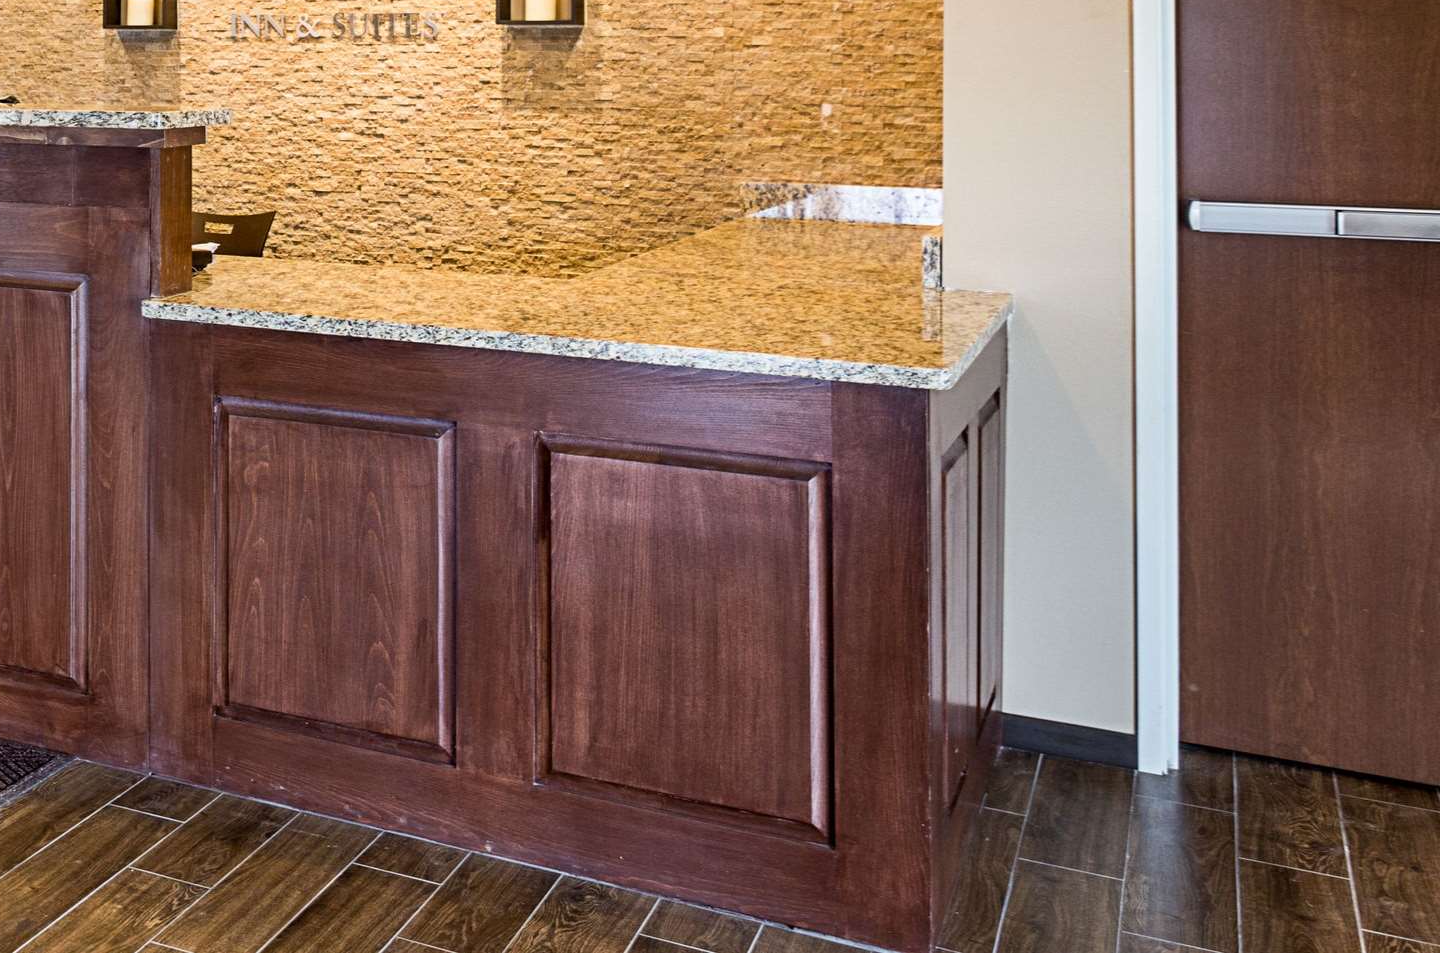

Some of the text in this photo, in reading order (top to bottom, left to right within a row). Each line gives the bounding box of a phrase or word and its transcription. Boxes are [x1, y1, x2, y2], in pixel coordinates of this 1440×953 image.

[230, 12, 440, 41] INN & SUITES
